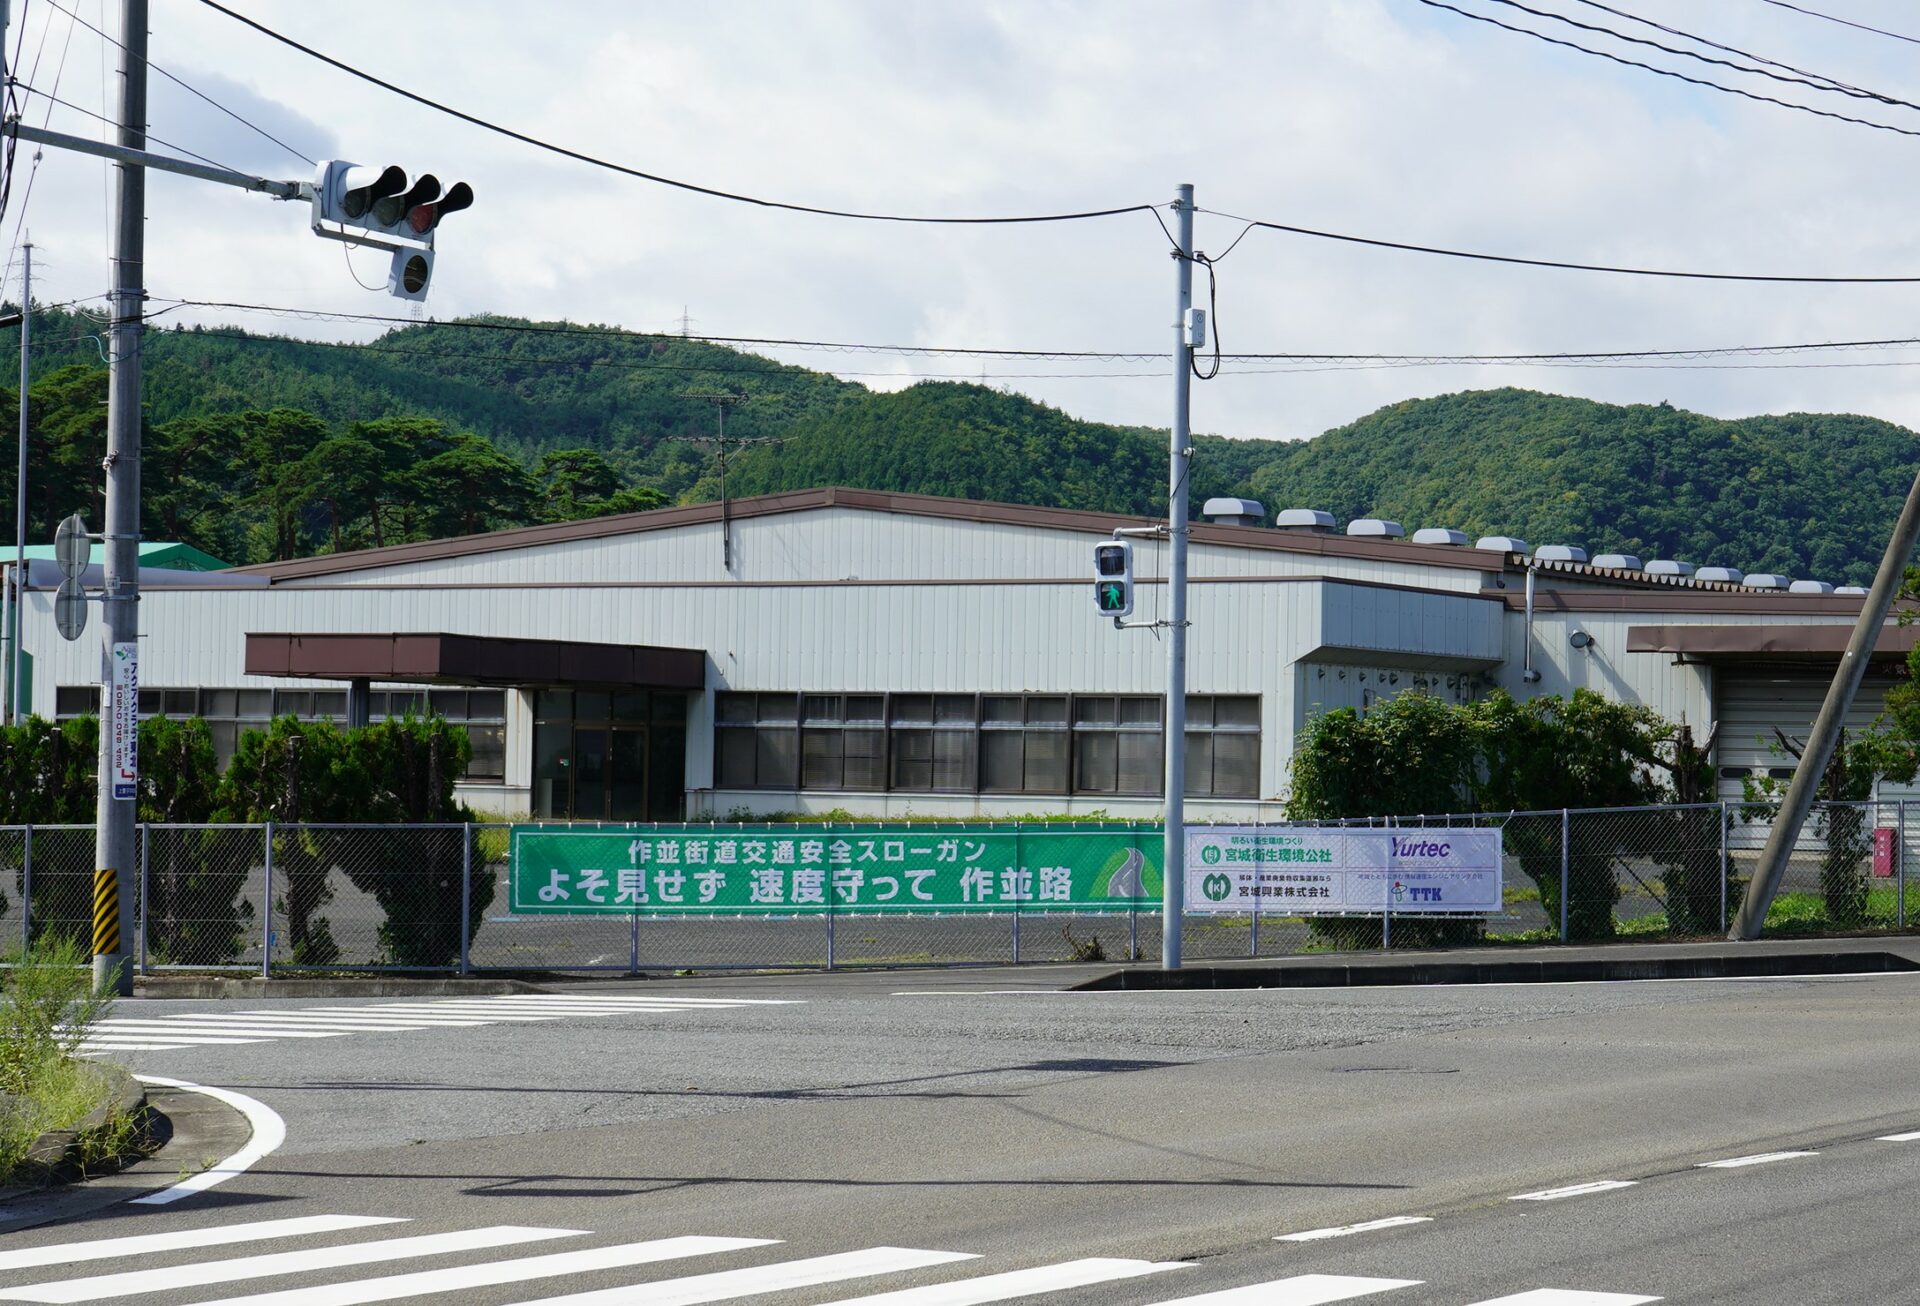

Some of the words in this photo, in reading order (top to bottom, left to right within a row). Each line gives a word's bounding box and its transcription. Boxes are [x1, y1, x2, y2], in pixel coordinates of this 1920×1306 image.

[628, 839, 986, 865] 作並街道交通安全スローガン
[1225, 848, 1332, 863] 宮城衛生環境公社
[1391, 837, 1451, 857] Yurtec
[538, 869, 726, 904] よそ見せず
[750, 868, 937, 903] 速度守って
[959, 866, 1073, 902] 作並路
[1239, 886, 1330, 898] 宮城興業株式会社
[1410, 888, 1442, 901] TTK
